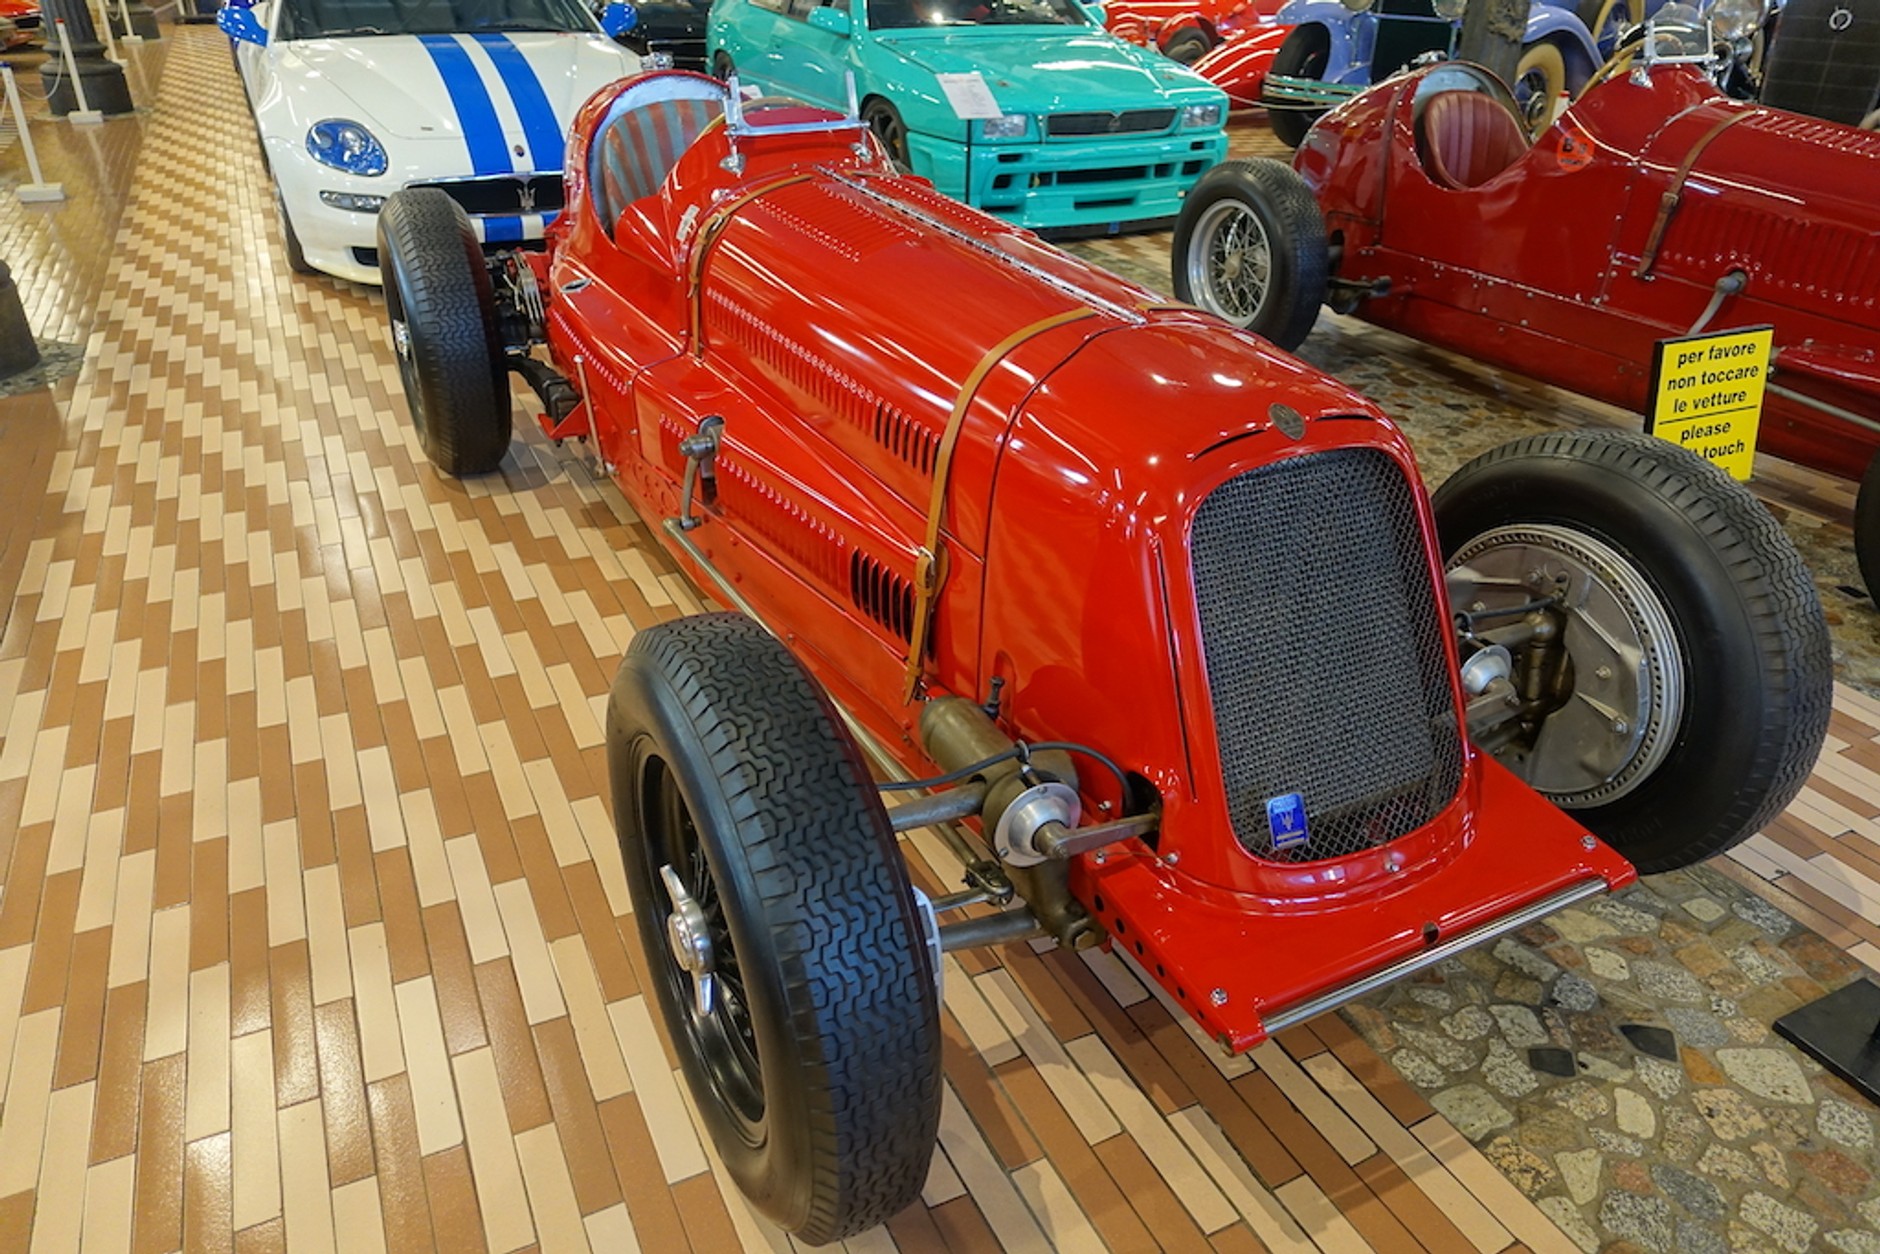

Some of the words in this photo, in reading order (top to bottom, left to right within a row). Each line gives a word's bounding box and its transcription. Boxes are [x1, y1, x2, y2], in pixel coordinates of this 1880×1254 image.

[1677, 350, 1704, 368] per
[1708, 342, 1757, 361] favore
[1667, 375, 1696, 391] non
[1701, 365, 1759, 385] toccare
[1673, 398, 1687, 413] le
[1692, 390, 1747, 410] vetture
[1680, 421, 1732, 444] please
[1703, 439, 1745, 459] touch
